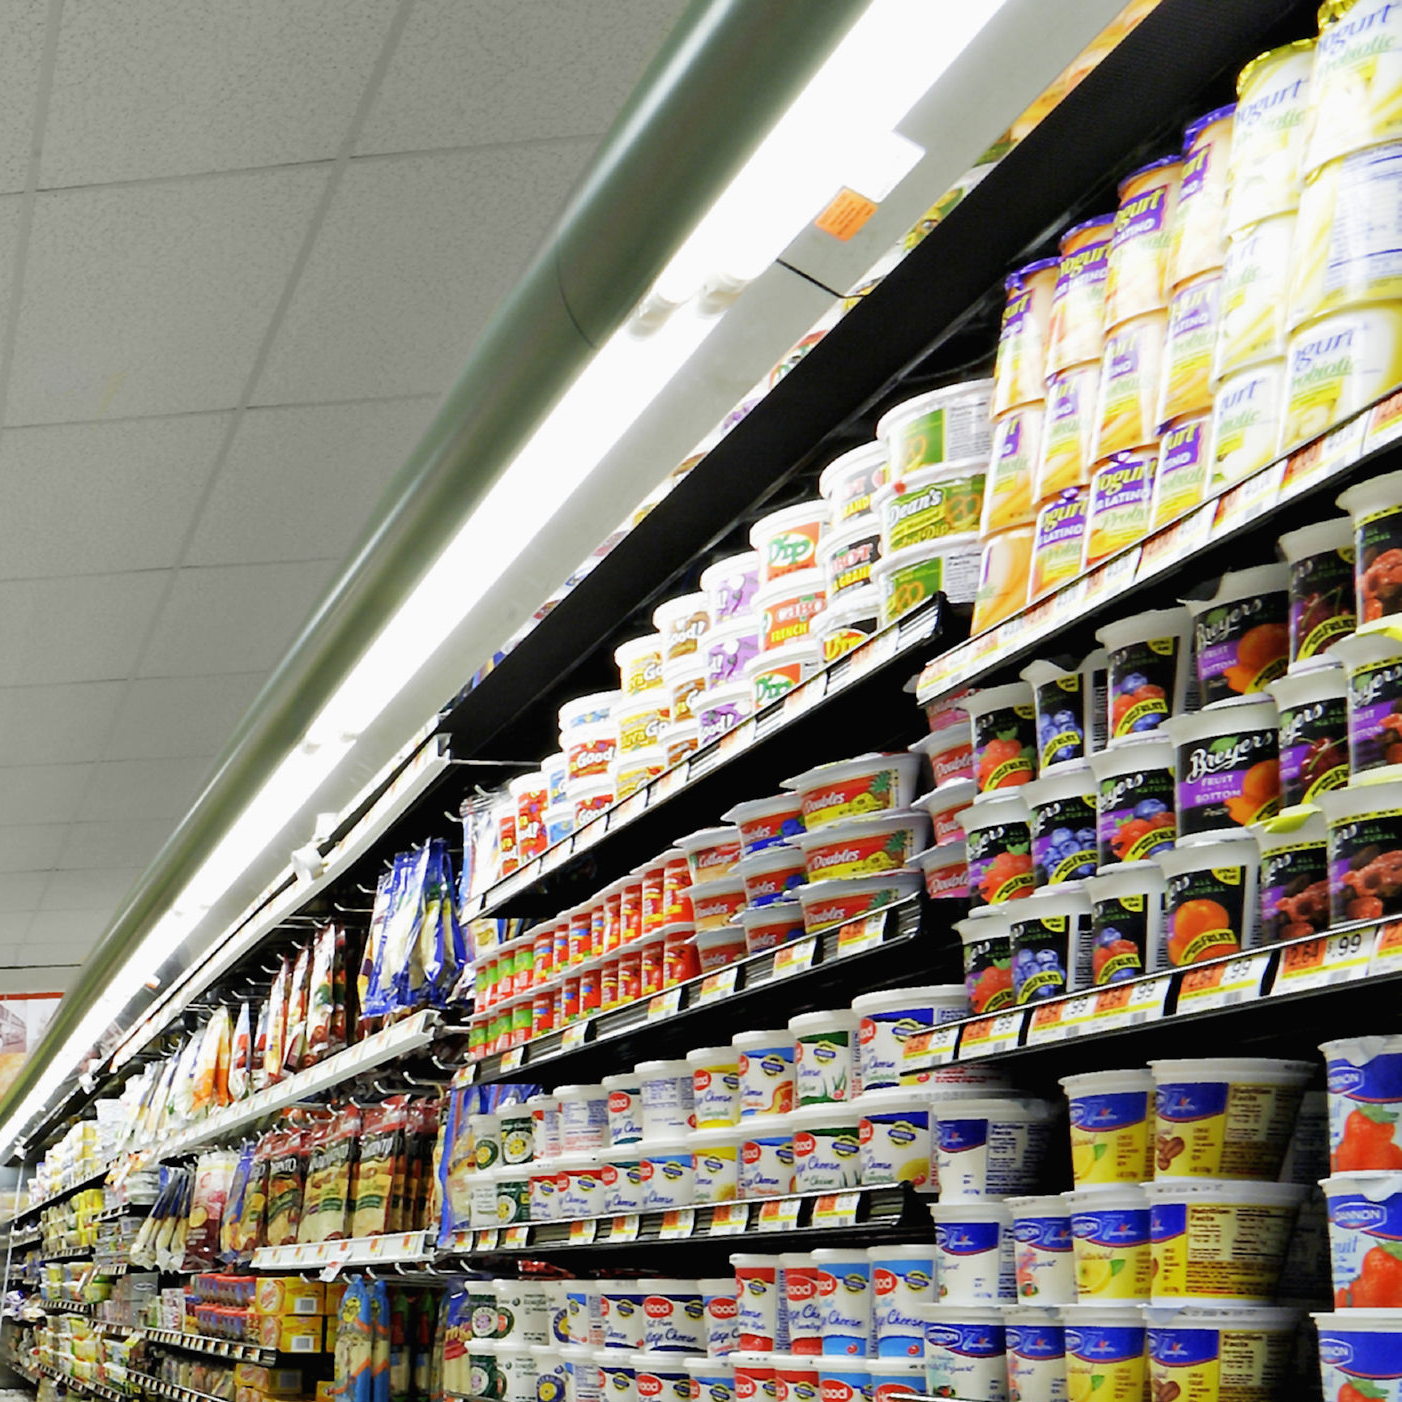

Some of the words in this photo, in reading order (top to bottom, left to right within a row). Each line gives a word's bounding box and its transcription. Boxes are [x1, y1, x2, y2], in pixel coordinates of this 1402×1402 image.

[889, 488, 943, 526] Dean's
[768, 537, 810, 566] Dip
[770, 622, 807, 643] FRENCH
[1197, 599, 1262, 649] Breyers
[1204, 645, 1229, 659] FRUIT
[1186, 732, 1273, 783] Breyers
[1201, 773, 1234, 787] FRUIT
[804, 791, 845, 814] Doubles
[1195, 787, 1241, 804] BOTTOM
[813, 849, 860, 870] Doubles
[806, 907, 845, 926] Doubles
[1200, 931, 1236, 950] FRUIT
[828, 1311, 864, 1327] Cheese
[887, 1311, 925, 1327] Cheese
